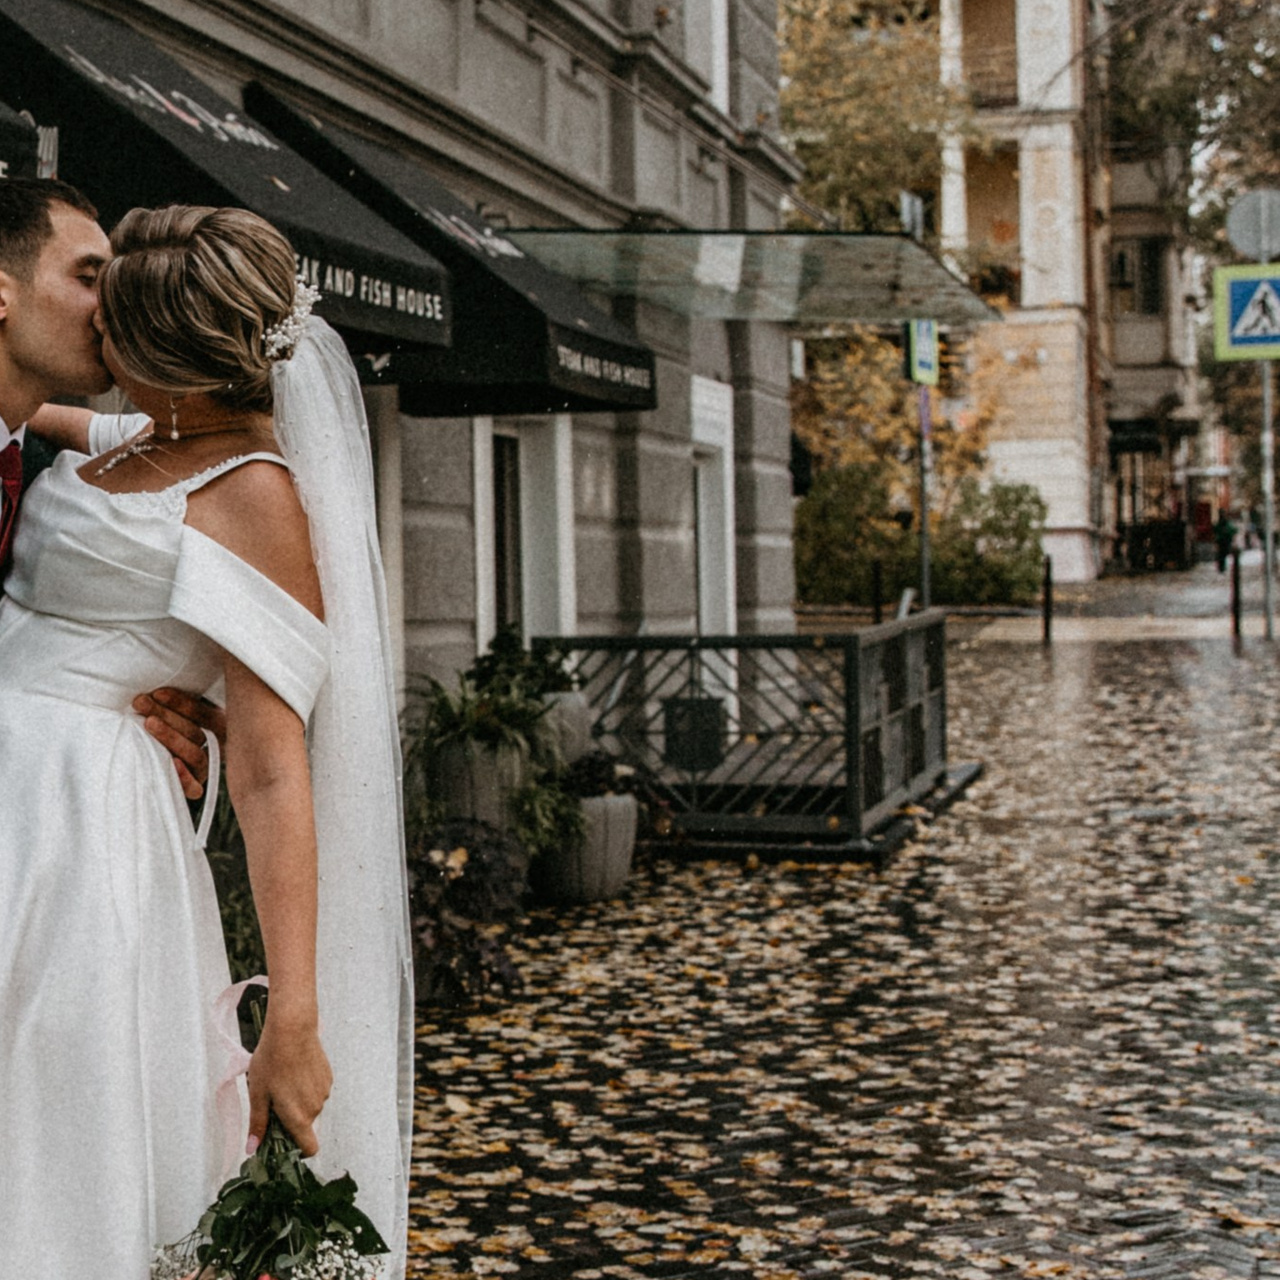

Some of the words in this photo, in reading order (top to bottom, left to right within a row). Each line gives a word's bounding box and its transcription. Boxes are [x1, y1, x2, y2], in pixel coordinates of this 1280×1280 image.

[324, 264, 355, 298] AND
[360, 274, 392, 308] FISH
[396, 284, 443, 320] HOUSE
